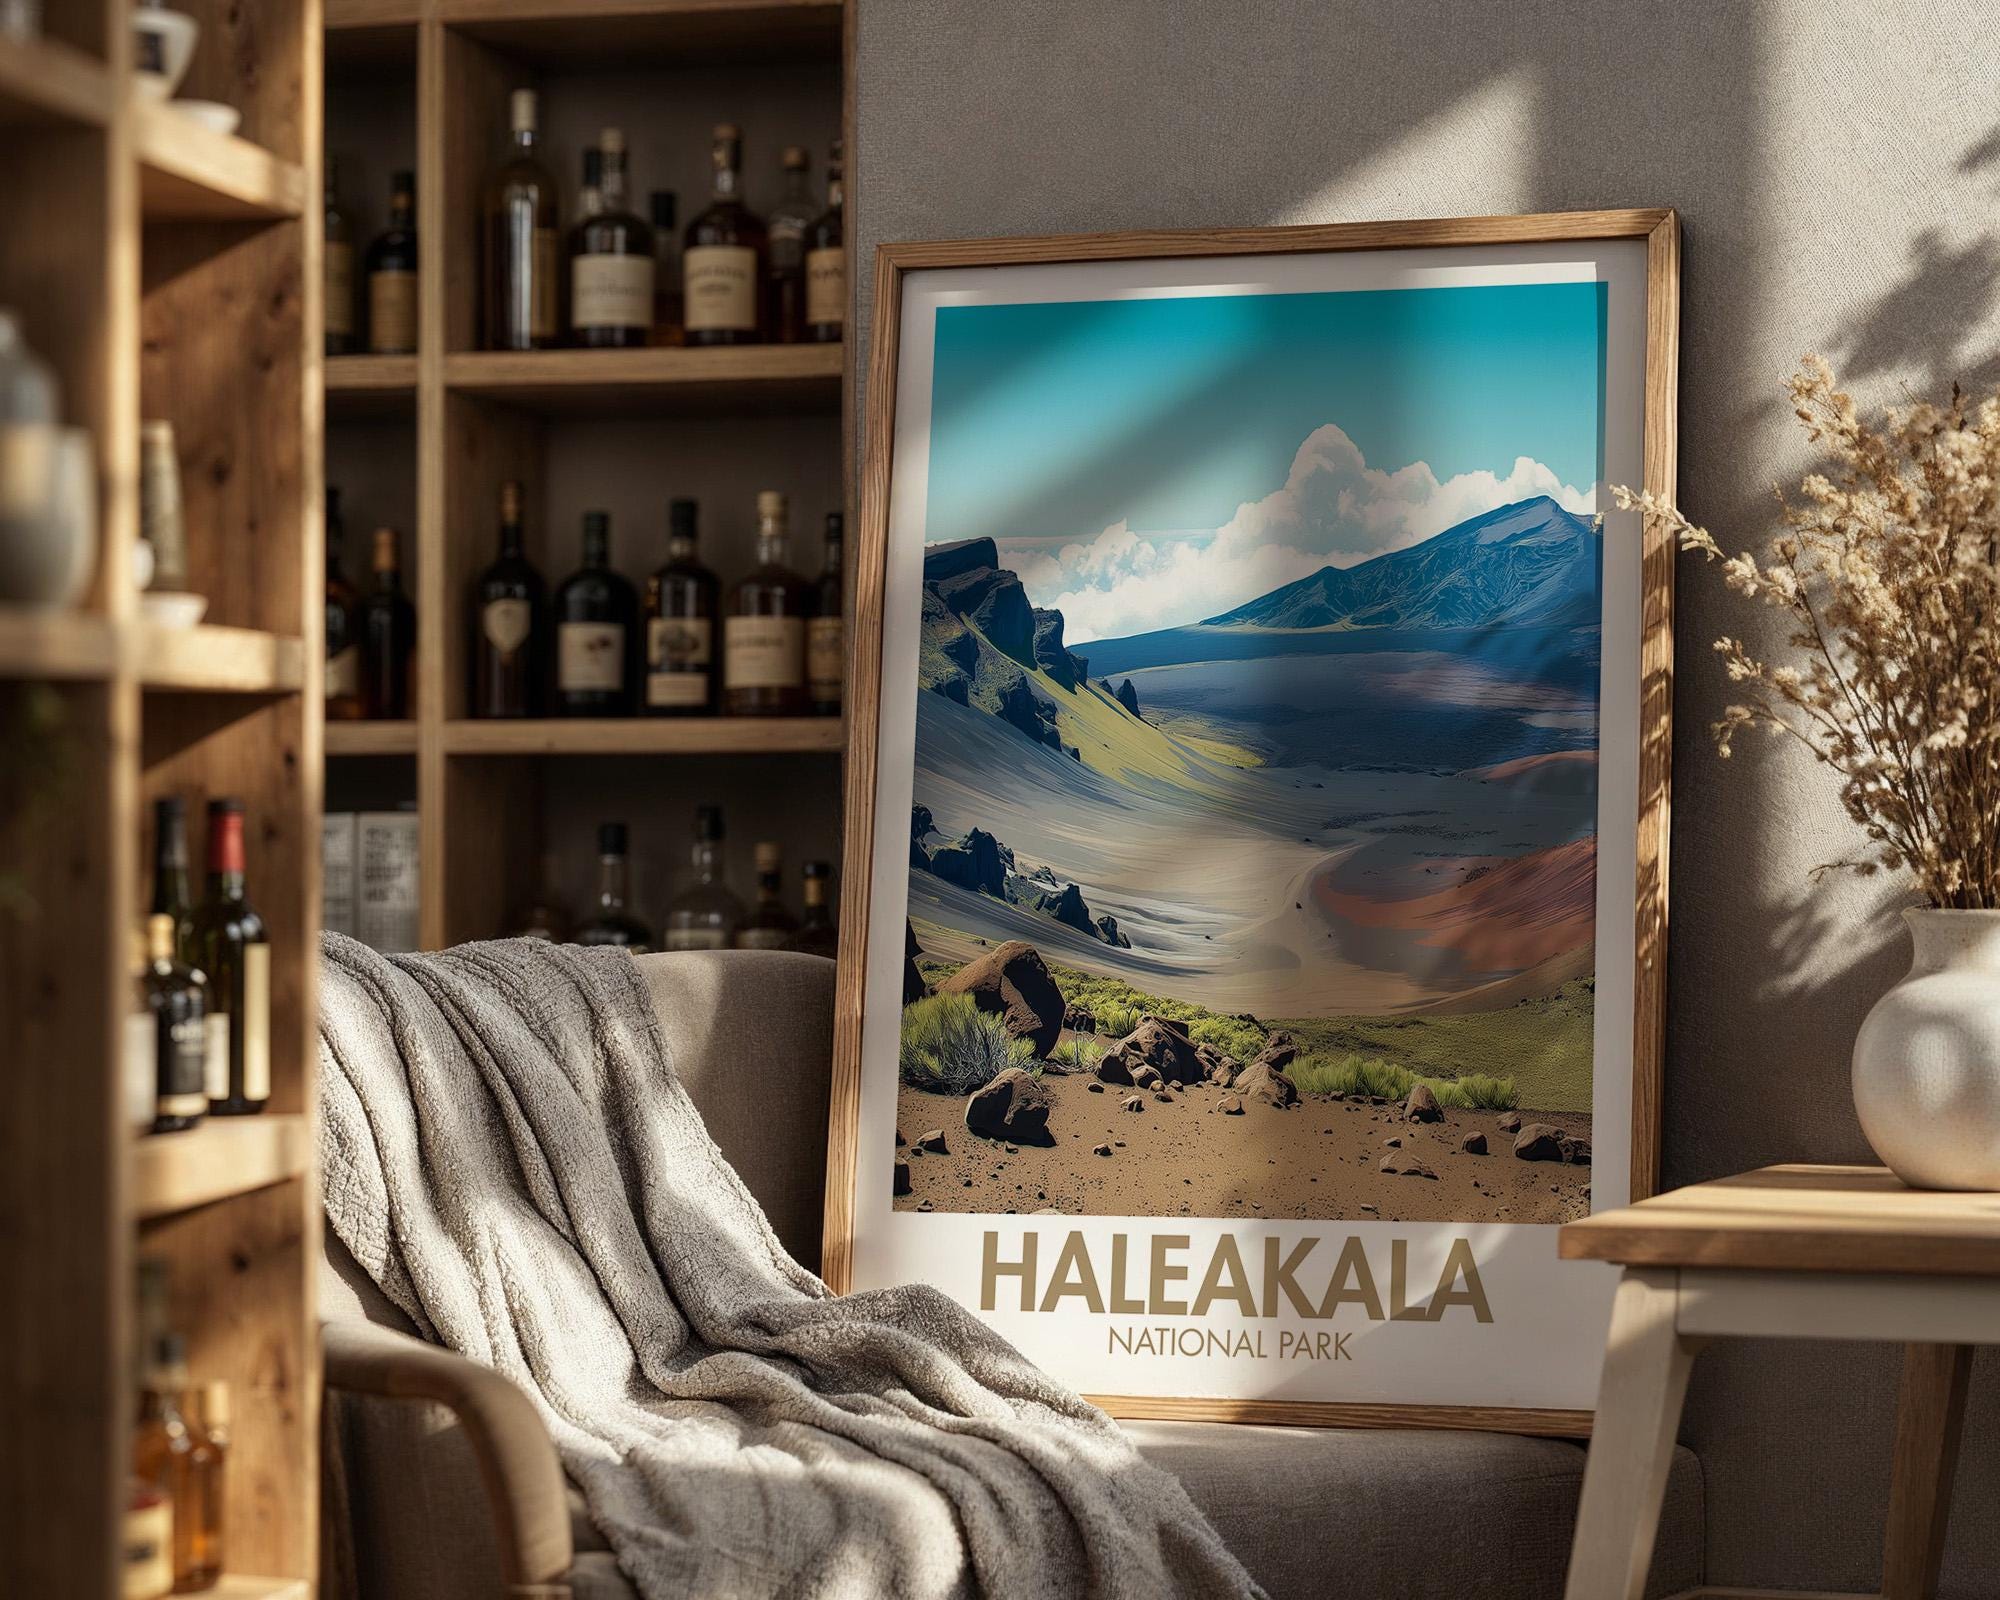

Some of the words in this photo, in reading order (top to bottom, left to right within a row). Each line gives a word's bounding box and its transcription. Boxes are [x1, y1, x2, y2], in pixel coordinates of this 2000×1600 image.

[980, 1231, 1494, 1323] HALEAKALA
[1108, 1327, 1267, 1359] NATIONAL
[1279, 1331, 1353, 1361] PARK
